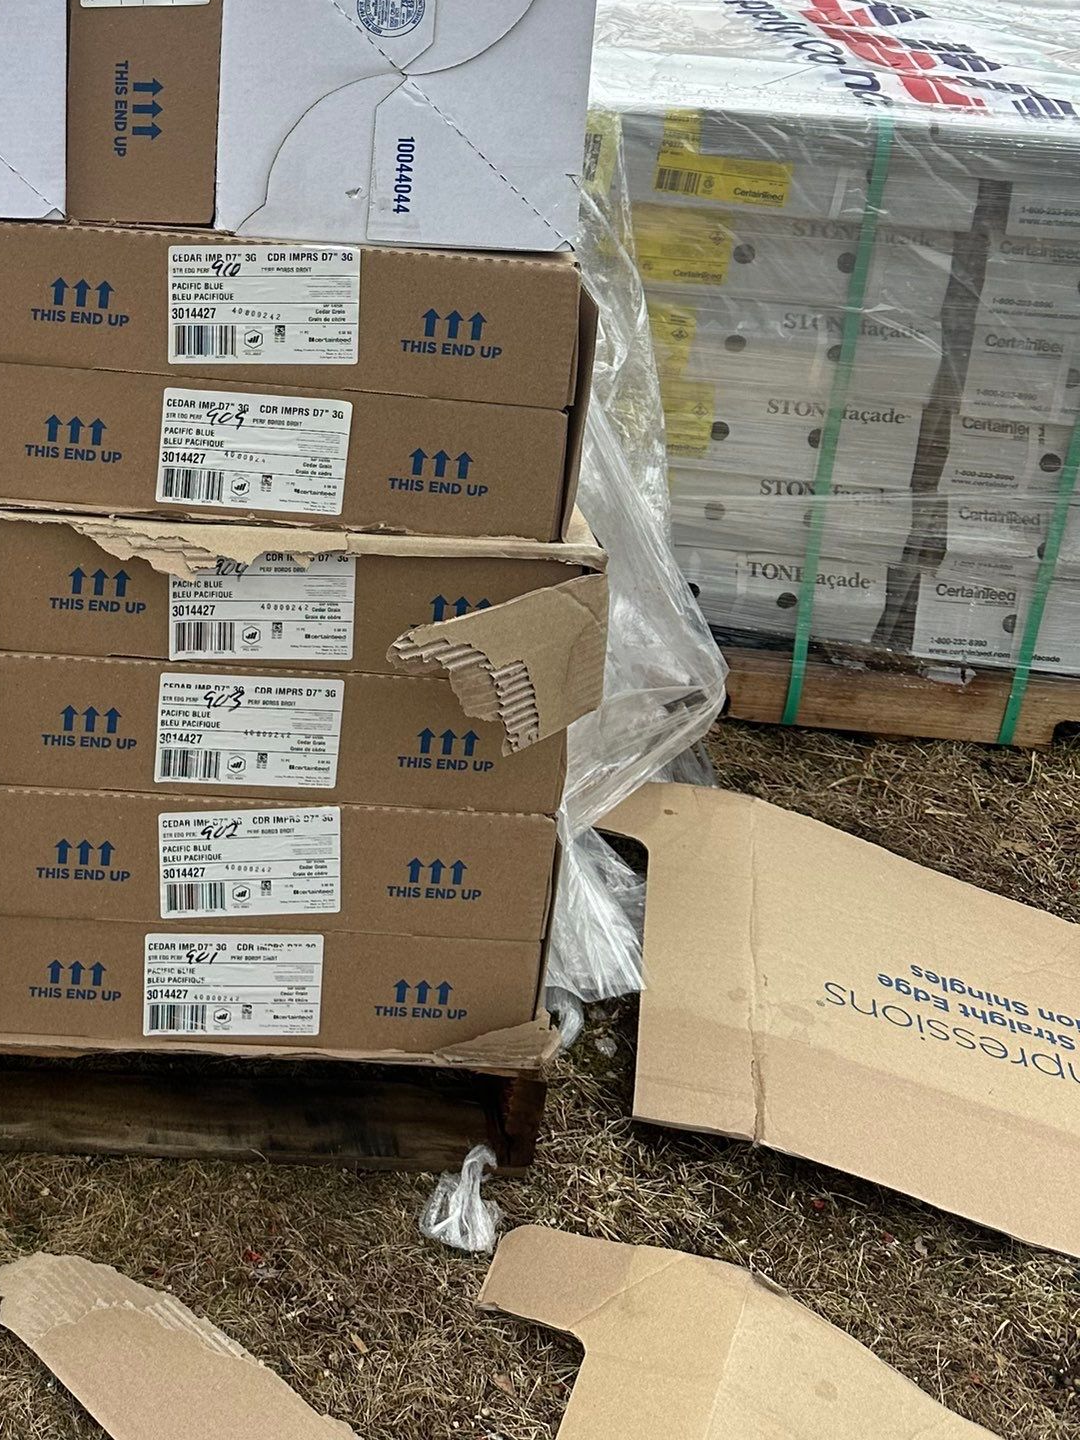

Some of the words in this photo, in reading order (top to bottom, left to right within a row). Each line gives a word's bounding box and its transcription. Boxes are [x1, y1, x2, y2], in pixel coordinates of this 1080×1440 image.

[392, 136, 415, 214] 10044044
[733, 187, 784, 201] CertainTeed
[172, 253, 202, 262] CEDAR
[205, 253, 222, 262] IMP
[245, 253, 257, 262] 3G
[267, 252, 286, 262] CDR
[289, 252, 318, 262] IMPRS
[321, 252, 338, 262] D7"
[342, 252, 353, 262] 3G
[172, 282, 202, 290] PACIFIC
[204, 282, 224, 290] BLUE
[172, 293, 192, 301] BLEU
[194, 293, 234, 301] PACIFIQUE
[171, 307, 217, 320] 3014427
[400, 339, 437, 354] THIS
[441, 342, 476, 357] END
[480, 345, 503, 359] UP
[49, 597, 84, 611] THIS
[88, 599, 121, 613] END
[125, 601, 147, 615] UP
[163, 867, 206, 879] 3014427
[877, 973, 950, 1013] Edge
[910, 964, 1029, 1016] Shingles
[374, 1005, 408, 1018] THIS
[411, 1007, 443, 1019] END
[446, 1008, 468, 1020] UP
[958, 1002, 1076, 1051] Straight
